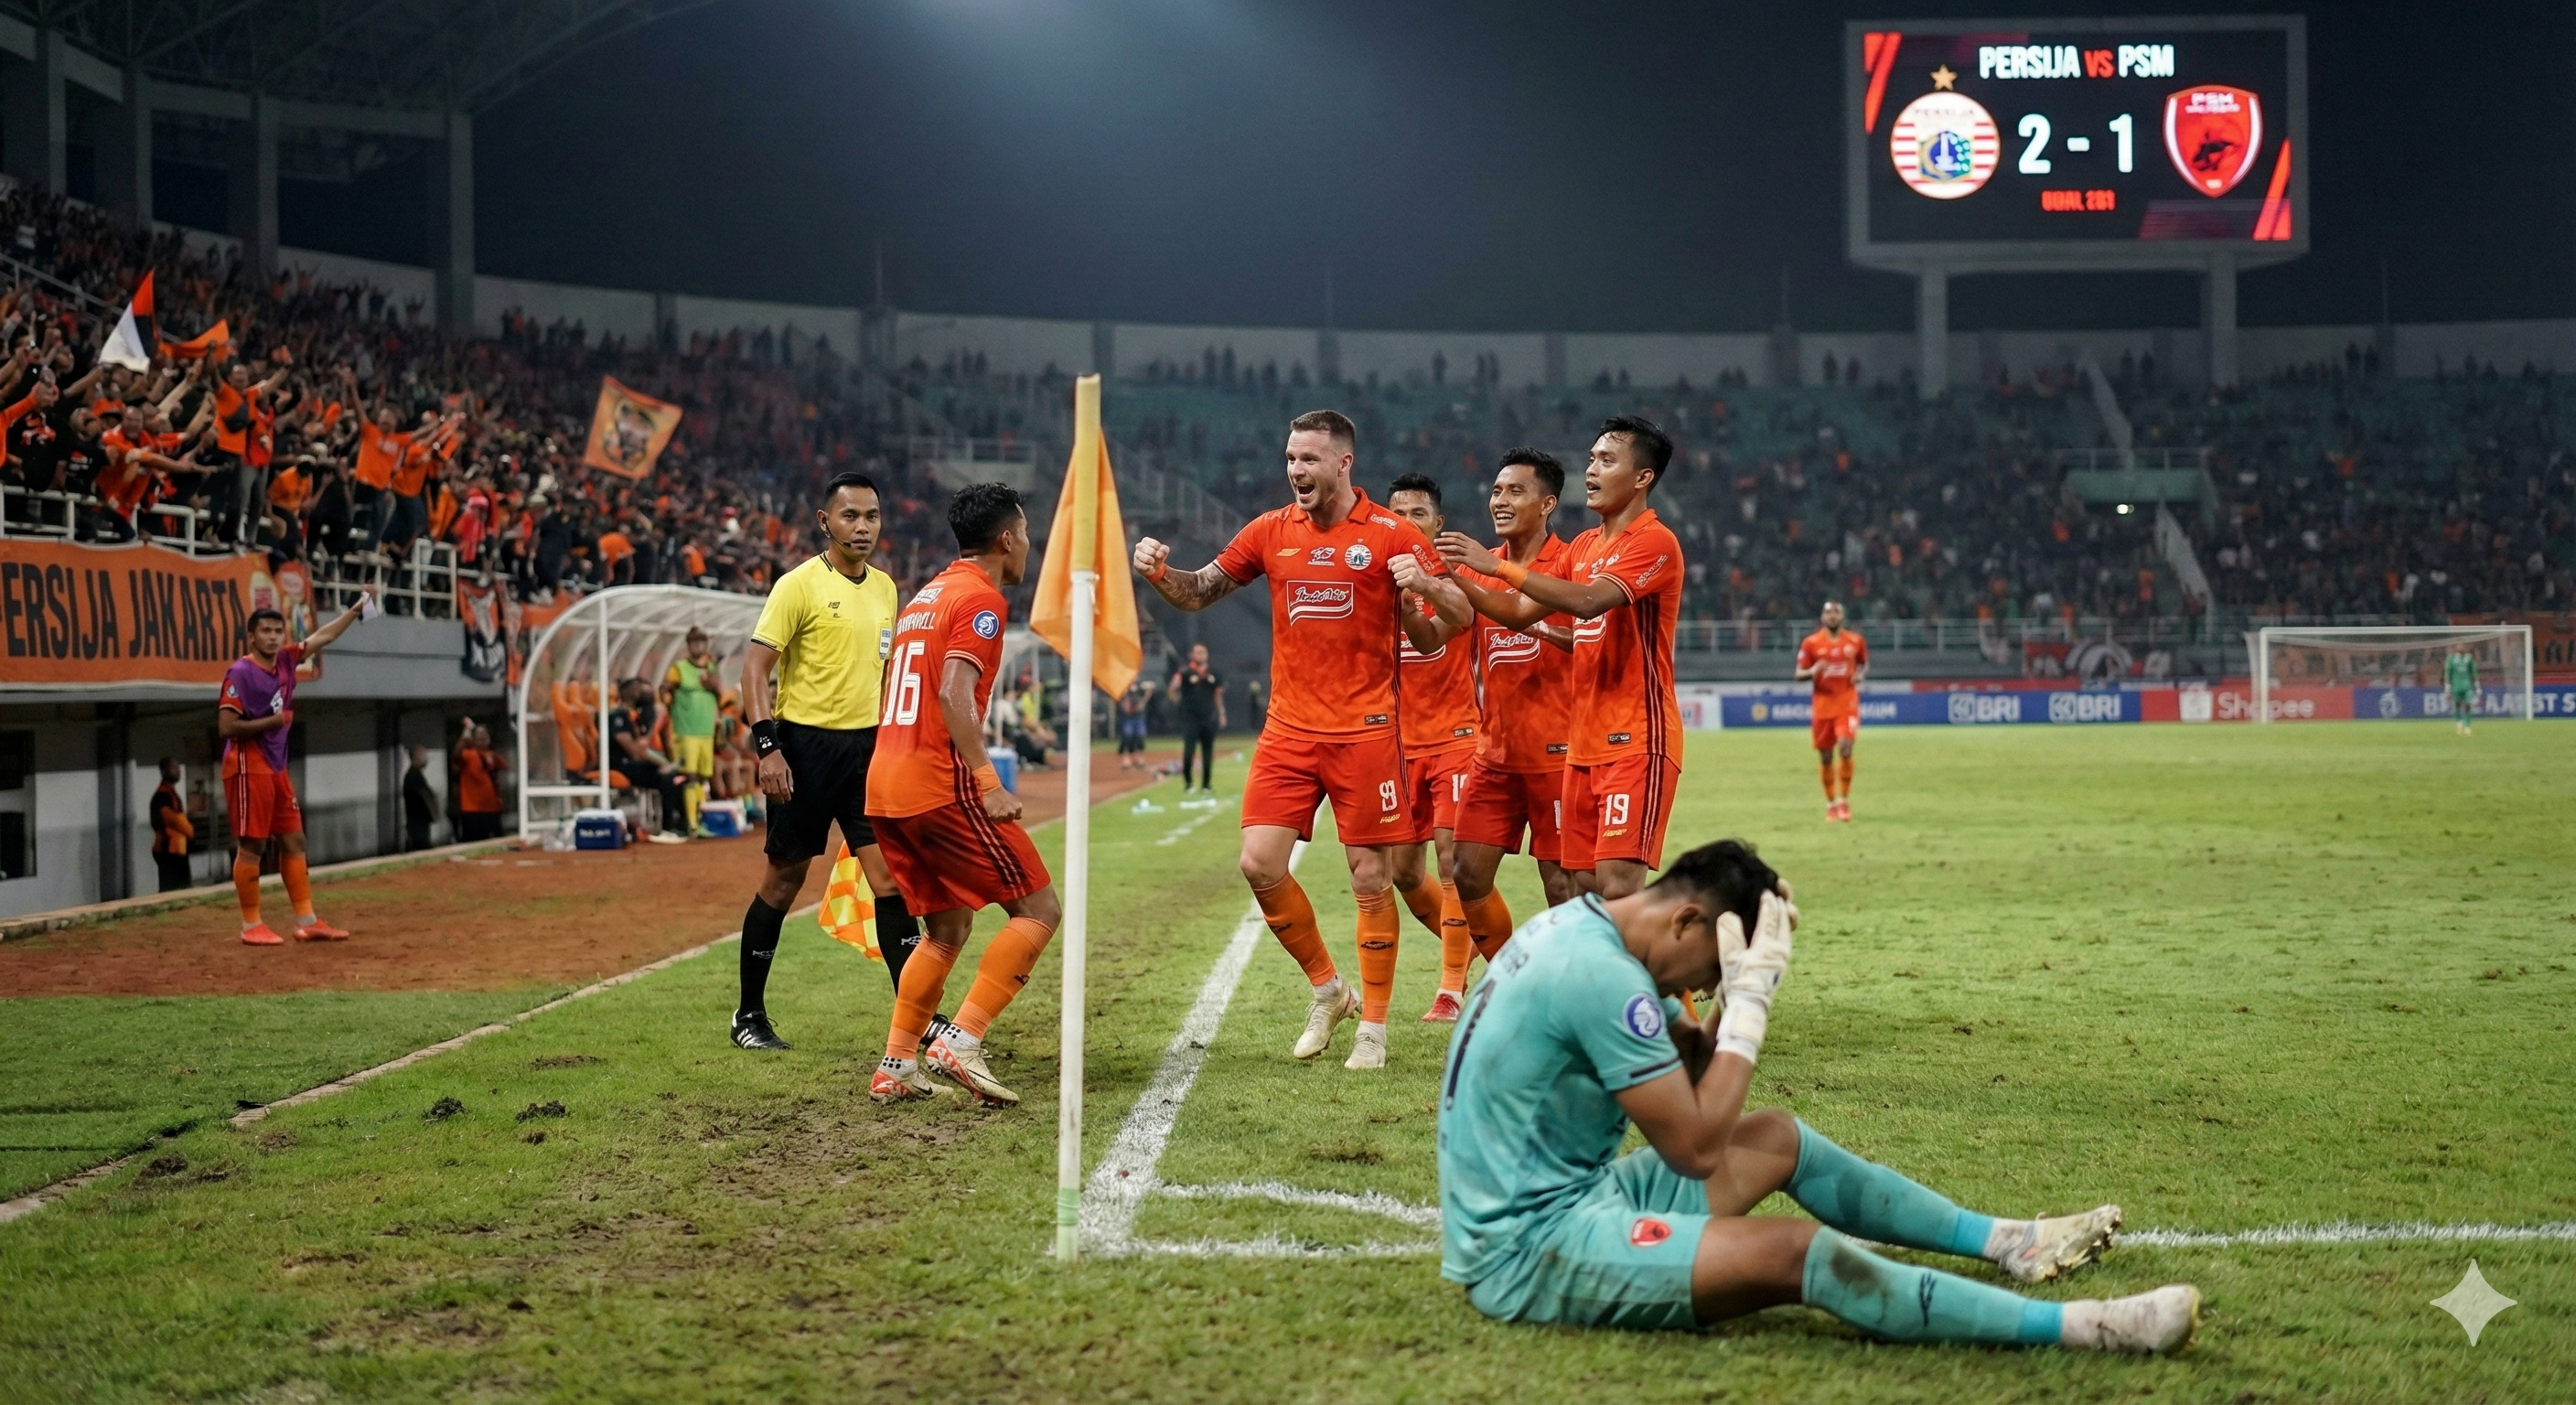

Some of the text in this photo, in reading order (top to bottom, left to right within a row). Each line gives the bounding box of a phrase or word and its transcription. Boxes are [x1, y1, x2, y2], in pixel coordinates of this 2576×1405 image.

[1979, 45, 2081, 80] PERSIJA
[2118, 44, 2174, 78] PSM
[2018, 113, 2052, 175] 2
[2109, 113, 2133, 173] 1
[0, 561, 250, 661] ERSIJA JAKARTA
[882, 639, 926, 727] 16
[1977, 695, 2021, 723] BRI
[2078, 693, 2121, 721] BRI
[2217, 692, 2315, 720] Shopee
[1605, 793, 1630, 826] 19
